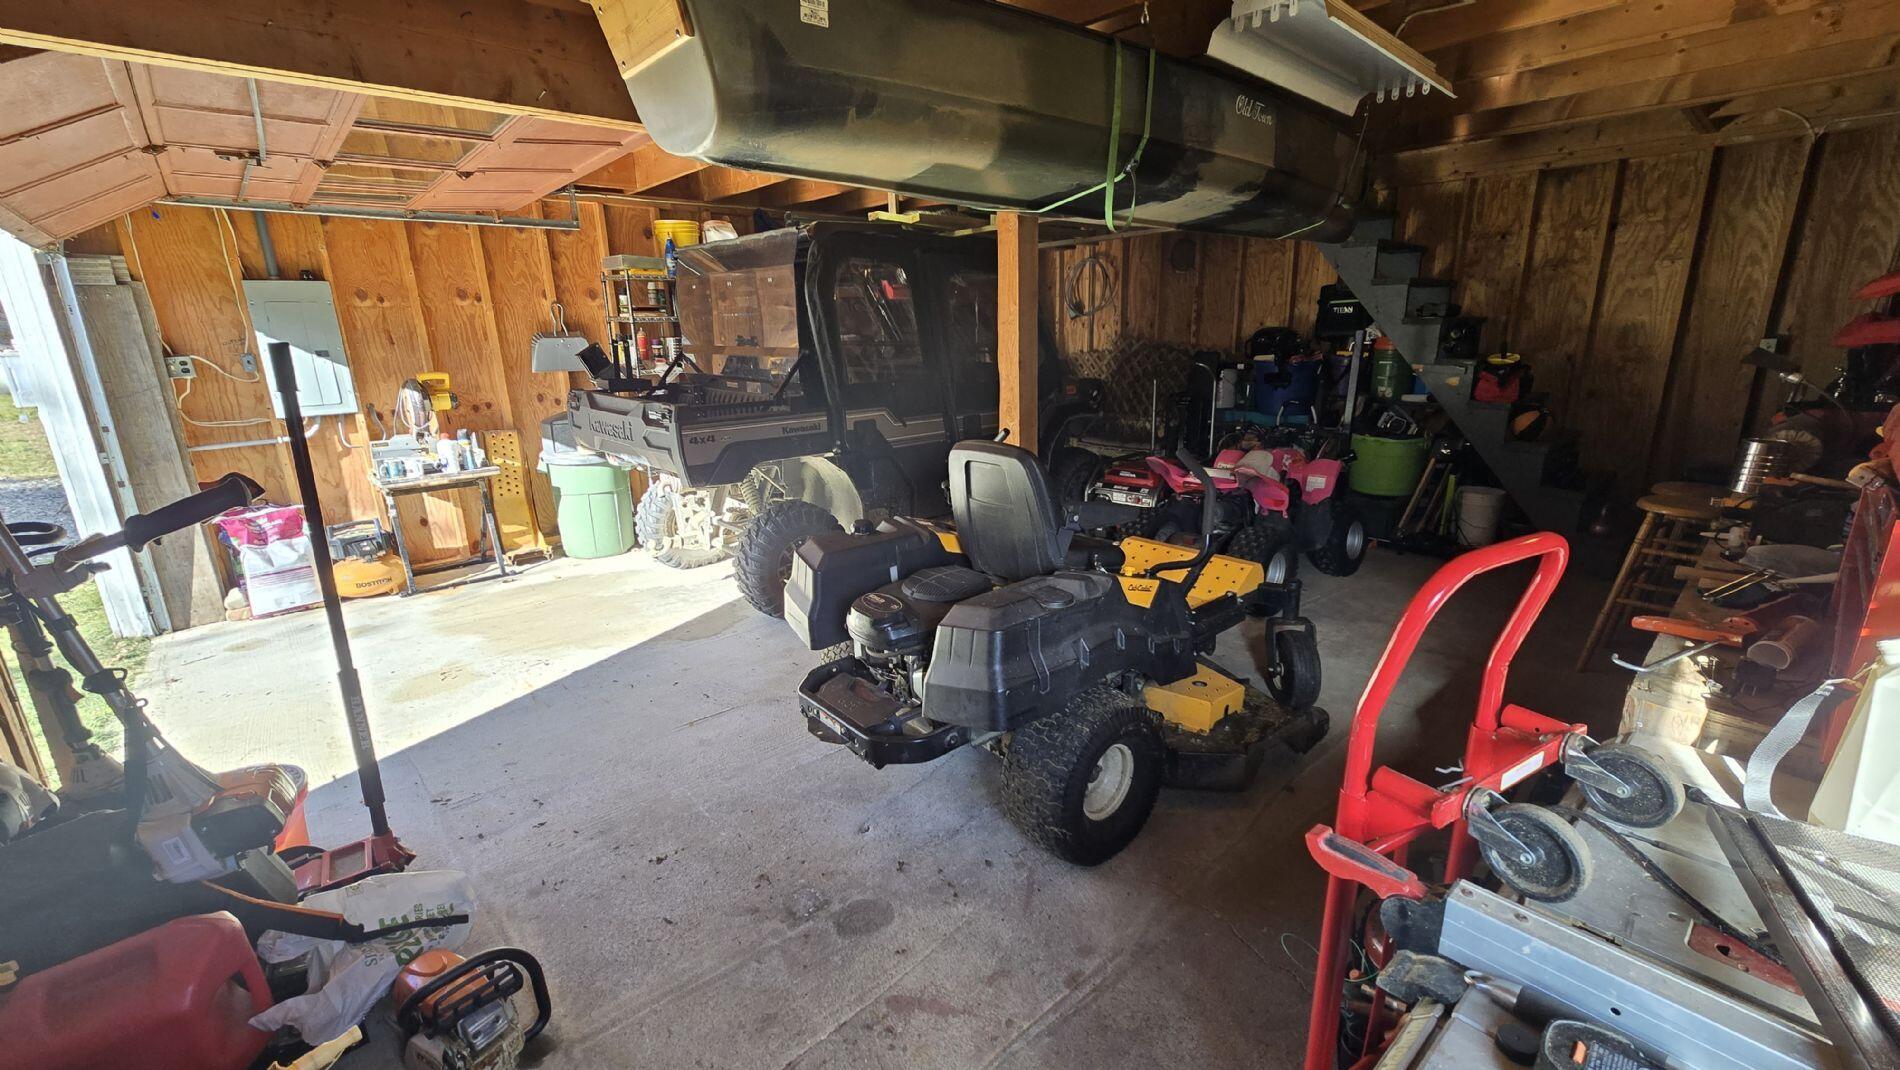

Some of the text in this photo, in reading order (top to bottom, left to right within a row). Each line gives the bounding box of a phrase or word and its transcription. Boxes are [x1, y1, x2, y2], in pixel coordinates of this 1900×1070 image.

[1235, 95, 1273, 126] Old Town
[1332, 306, 1354, 315] TITAN
[781, 422, 822, 435] Kawasaki
[355, 576, 393, 590] BOSTITCH
